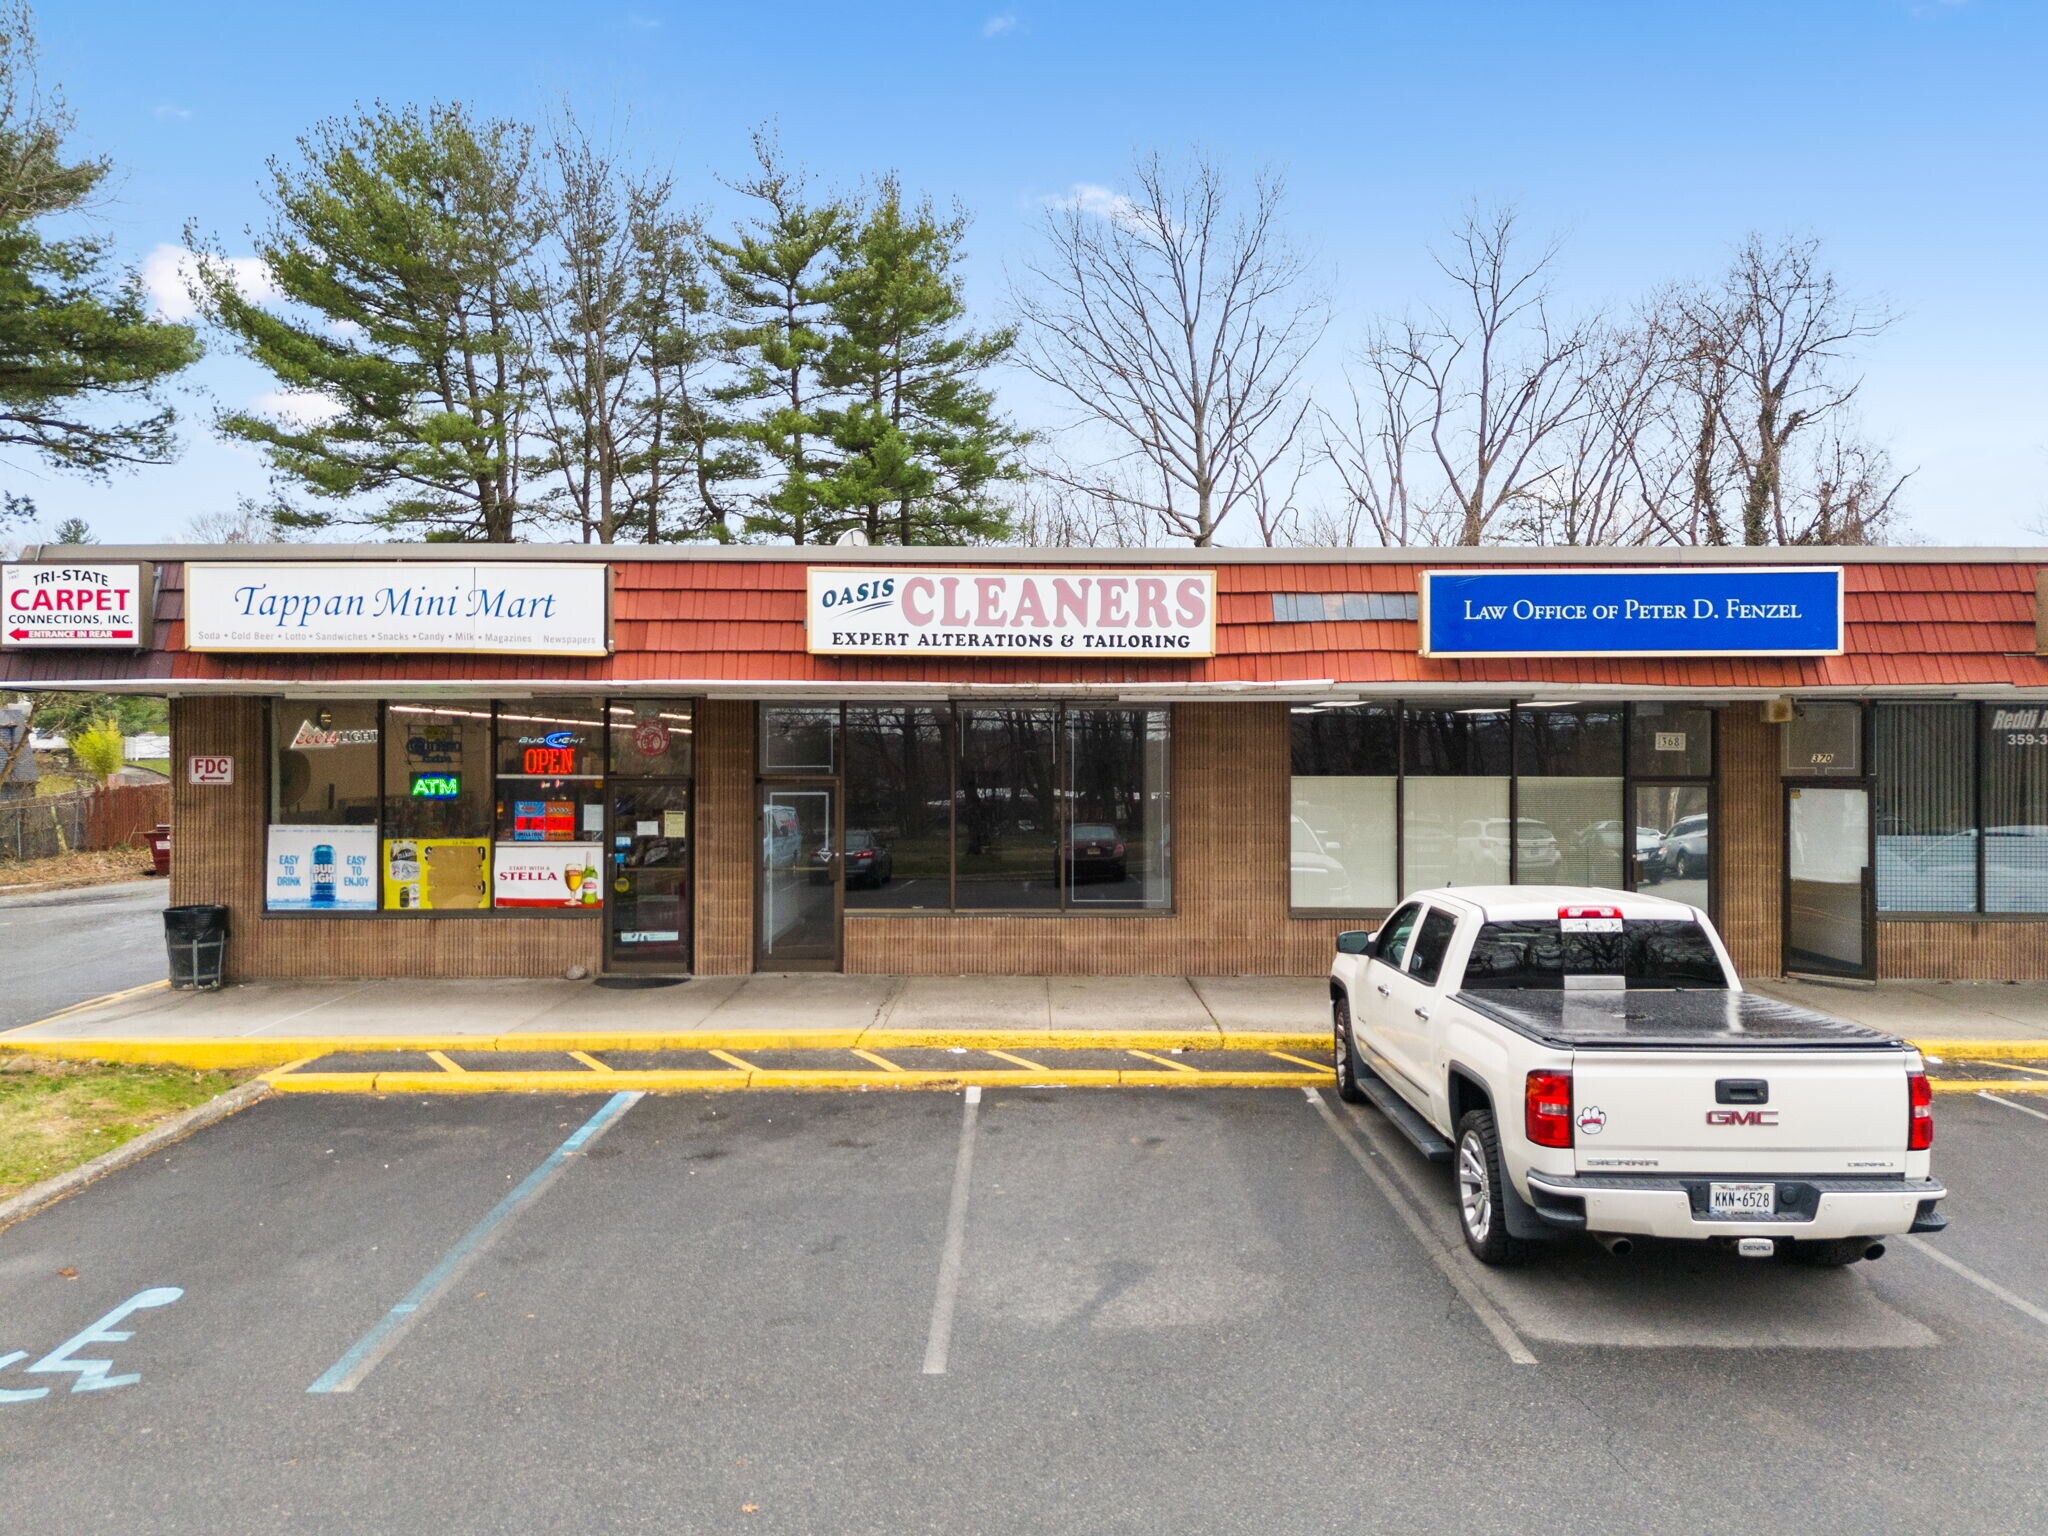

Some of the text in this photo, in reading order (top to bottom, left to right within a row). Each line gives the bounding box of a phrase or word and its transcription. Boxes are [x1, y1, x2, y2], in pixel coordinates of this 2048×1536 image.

[33, 569, 108, 587] TRI-STATE
[10, 588, 130, 611] CARPET
[822, 578, 895, 608] OASIS
[234, 583, 556, 627] Tappan Mini Mart
[901, 577, 1206, 628] CLEANERS
[1693, 598, 1719, 619] D.
[8, 614, 133, 625] CONNECTIONS, INC.
[28, 630, 113, 638] ENTRANCE IN REAR
[198, 632, 596, 645] Soda Cold Beer Lotto Sandwiches Snacks Candy Milk Magazines Newspapers
[832, 632, 1190, 648] EXPERT ALTERATIONS & TAILORING
[1992, 709, 2039, 729] Reddi
[295, 729, 378, 745] Coors LIGHT
[1662, 736, 1680, 747] 368
[524, 748, 575, 774] OPEN
[1811, 753, 1834, 763] 370
[194, 758, 228, 774] FDC
[412, 778, 457, 796] ATM
[279, 855, 300, 865] EASY
[346, 855, 367, 865] EASY
[285, 866, 295, 875] TO
[314, 864, 335, 873] BUD
[352, 866, 362, 875] TO
[277, 877, 301, 886] DRINK
[344, 877, 369, 886] ENJOY
[499, 872, 557, 880] STELLA
[1706, 1110, 1779, 1126] GMC
